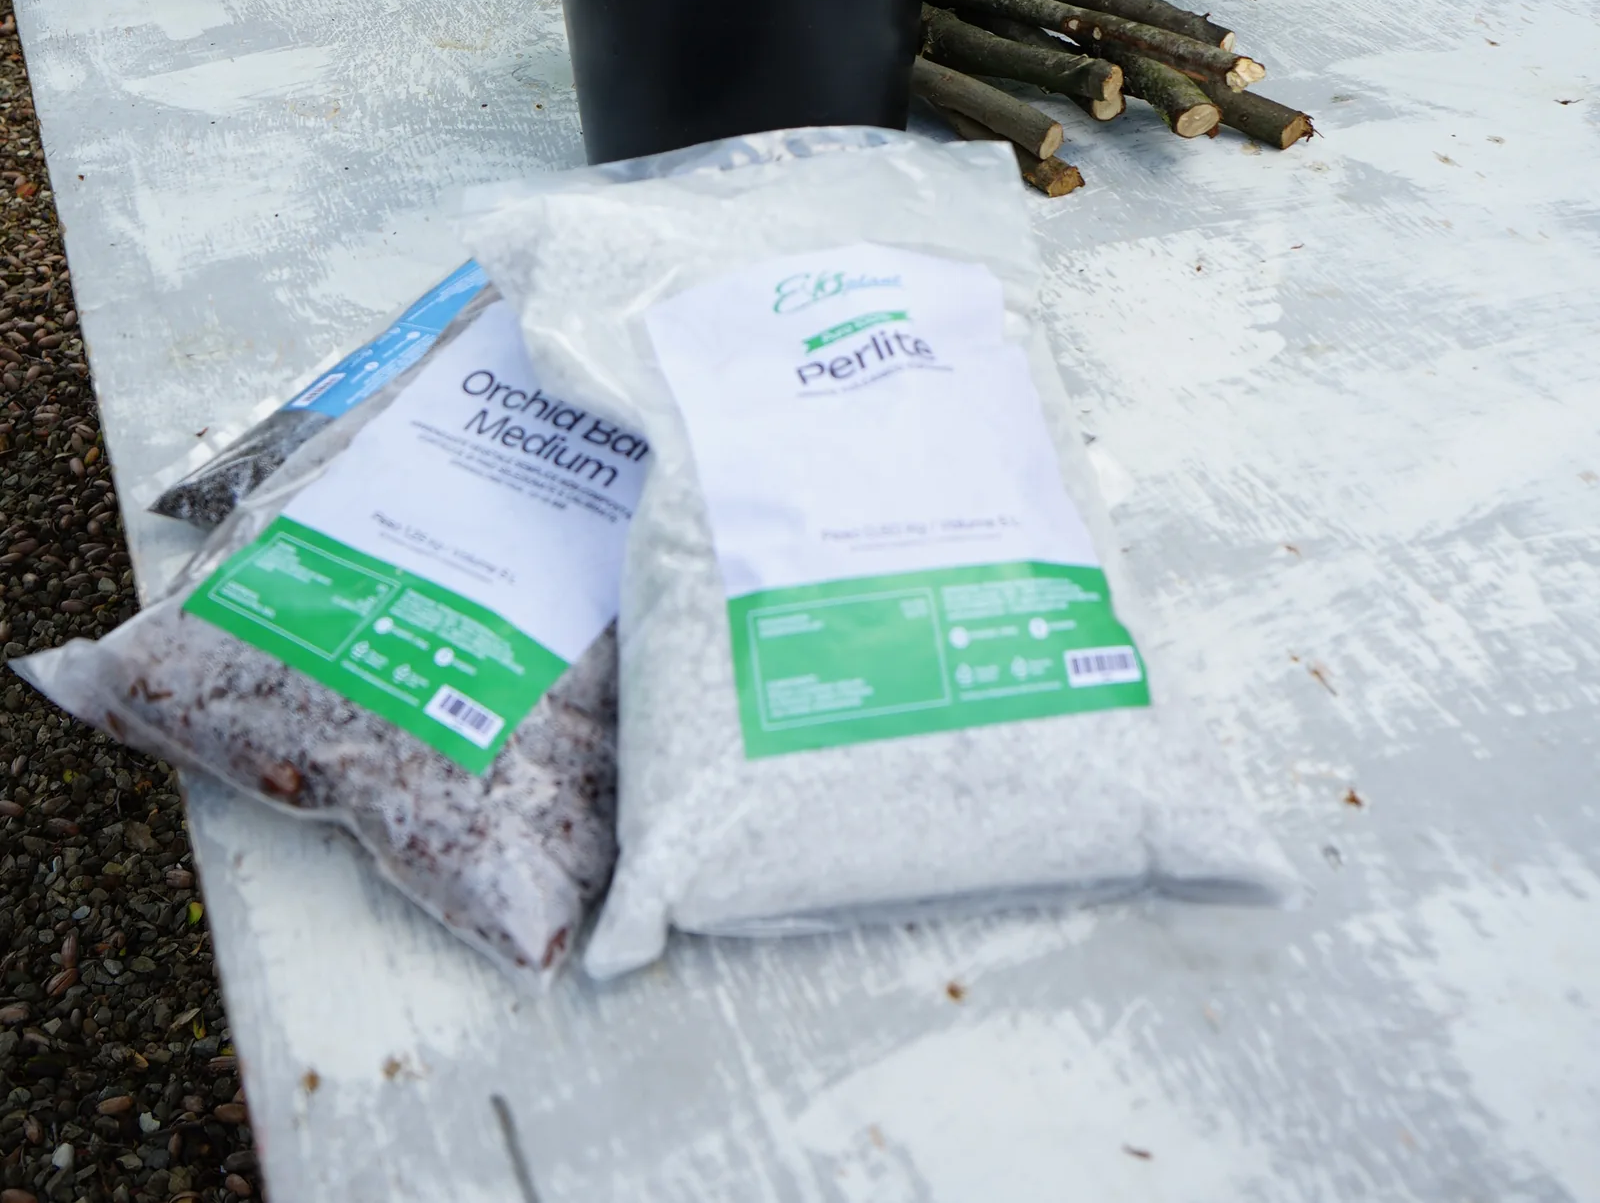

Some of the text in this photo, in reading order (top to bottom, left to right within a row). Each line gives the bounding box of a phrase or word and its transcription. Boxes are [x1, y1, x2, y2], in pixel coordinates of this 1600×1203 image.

[795, 329, 936, 386] Perlite
[461, 369, 585, 432] Orchid
[464, 408, 618, 489] Medium
